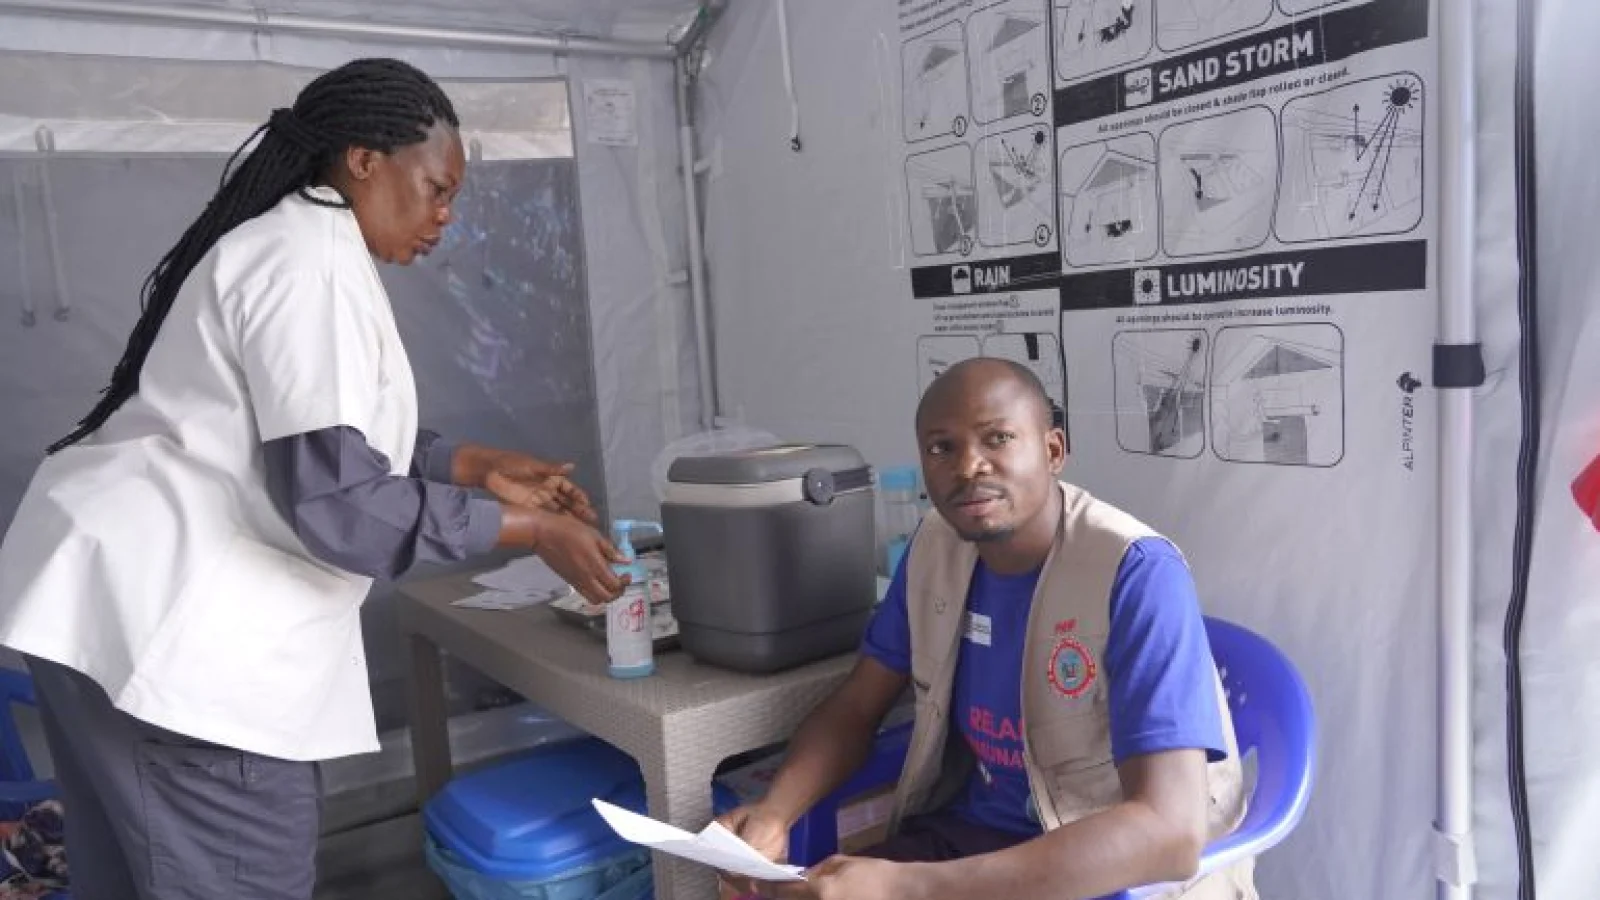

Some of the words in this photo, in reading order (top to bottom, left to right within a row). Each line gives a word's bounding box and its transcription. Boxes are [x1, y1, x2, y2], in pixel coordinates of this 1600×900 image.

[1159, 57, 1221, 93] SAND
[1225, 30, 1314, 77] STORM
[1172, 107, 1183, 118] be
[1184, 100, 1213, 114] closed
[1269, 80, 1301, 94] rolled
[1304, 77, 1315, 87] or
[974, 265, 1011, 288] RAIN
[1167, 262, 1304, 297] LUMINOSITY
[1402, 396, 1414, 472] ALPINTER
